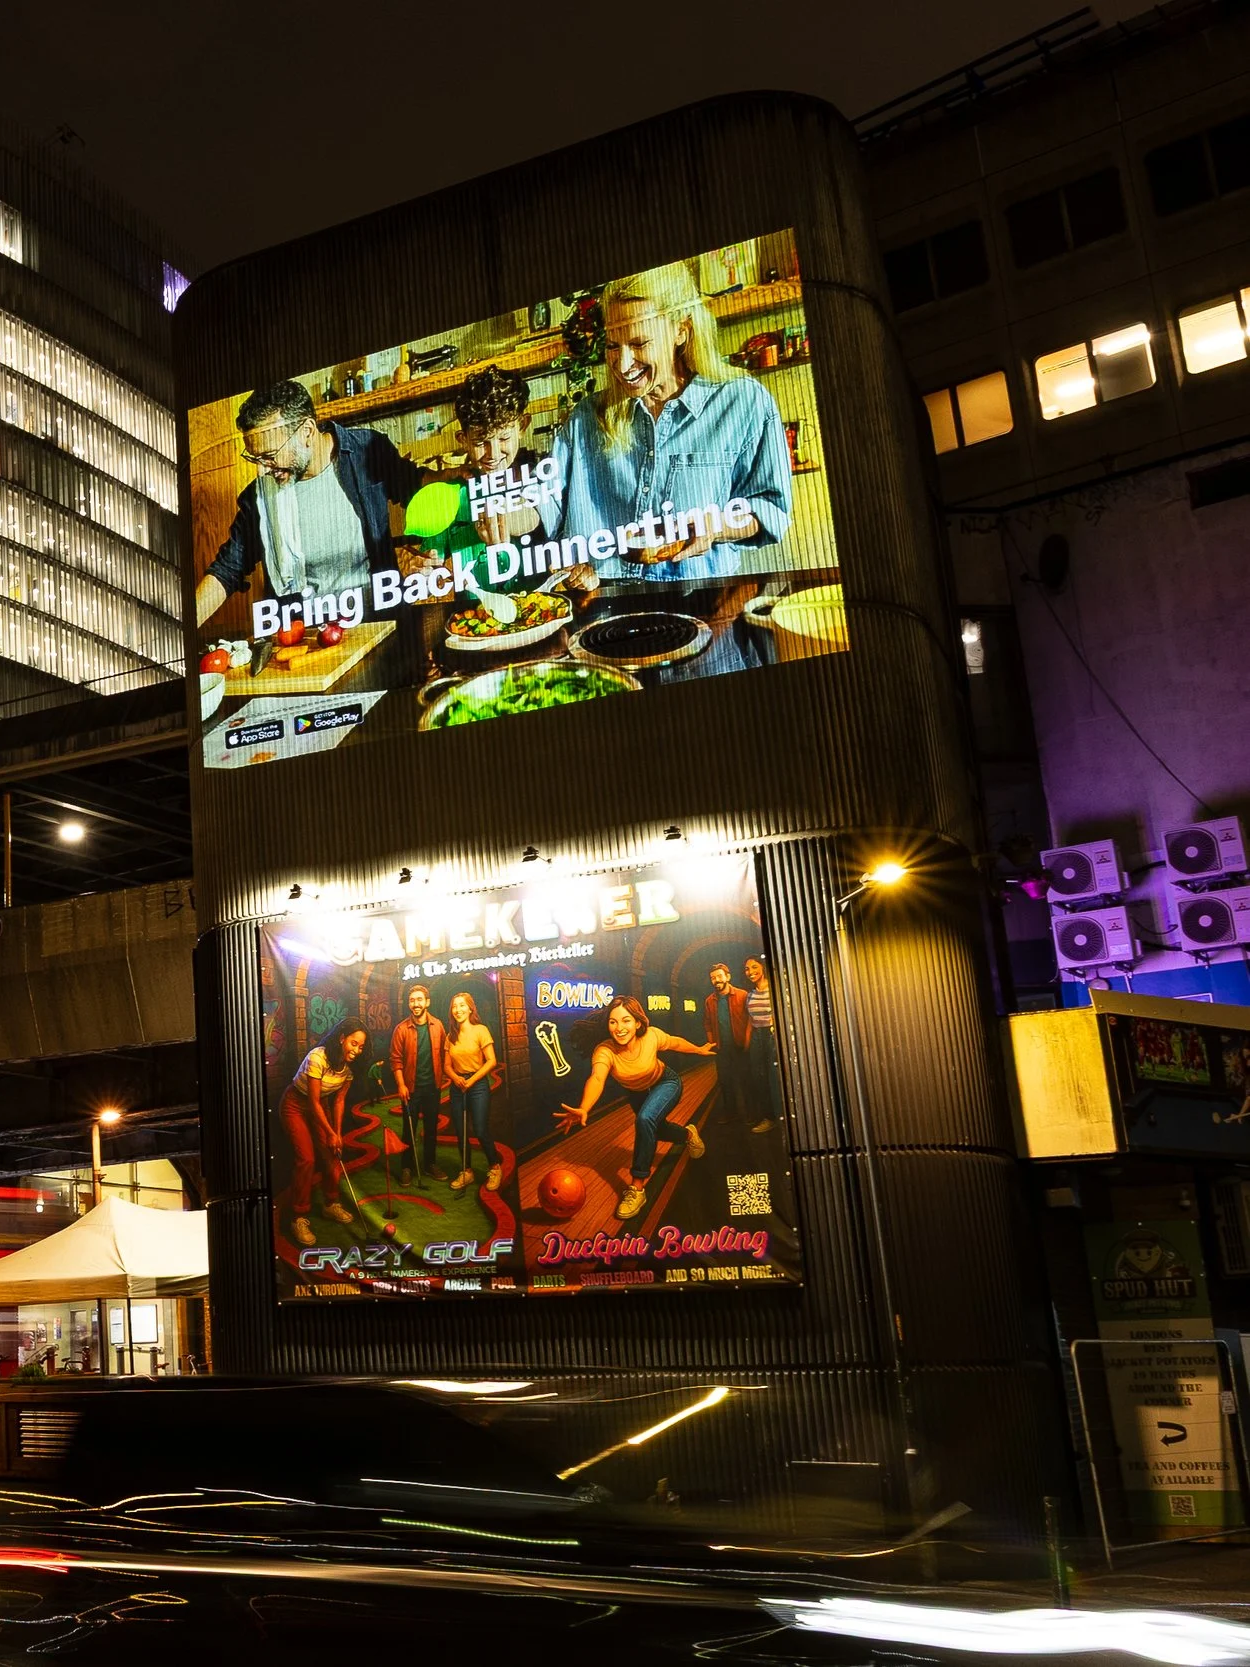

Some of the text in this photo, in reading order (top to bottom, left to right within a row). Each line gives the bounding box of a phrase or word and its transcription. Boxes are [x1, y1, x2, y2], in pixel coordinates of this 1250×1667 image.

[468, 457, 559, 499] HELLO
[470, 479, 564, 522] FRESH
[252, 496, 753, 639] Bring Back Dinnertime
[314, 712, 359, 728] Google Play
[240, 729, 280, 744] App Store
[402, 941, 594, 981] At The Bermondsey Bierkeller
[536, 981, 614, 1008] BOWLING
[299, 1238, 514, 1273] CRAZY GOLF
[537, 1225, 768, 1265] Duckpin Bowling
[295, 1284, 311, 1297] AXE
[313, 1283, 361, 1296] THROWING
[373, 1281, 398, 1294] DRIFT
[400, 1280, 431, 1293] CARTS
[444, 1278, 482, 1291] ARCADE
[491, 1277, 517, 1290] POOL
[533, 1275, 566, 1288] DARTS
[580, 1270, 655, 1287] SHUFFLEBOARD
[666, 1269, 687, 1282] AND
[690, 1268, 705, 1281] SO
[707, 1266, 739, 1281] MUCH
[366, 1270, 388, 1278] HOLE
[390, 1268, 440, 1278] IMMERSIVE
[442, 1266, 497, 1276] EXPERIENCE
[1104, 1279, 1192, 1298] SPUD HUT
[1130, 1330, 1183, 1340] LONDONS
[1157, 1356, 1216, 1366] POTATOES
[1152, 1461, 1176, 1471] AND
[1179, 1461, 1230, 1471] COFFEES
[1151, 1475, 1215, 1485] AVAILABLE
